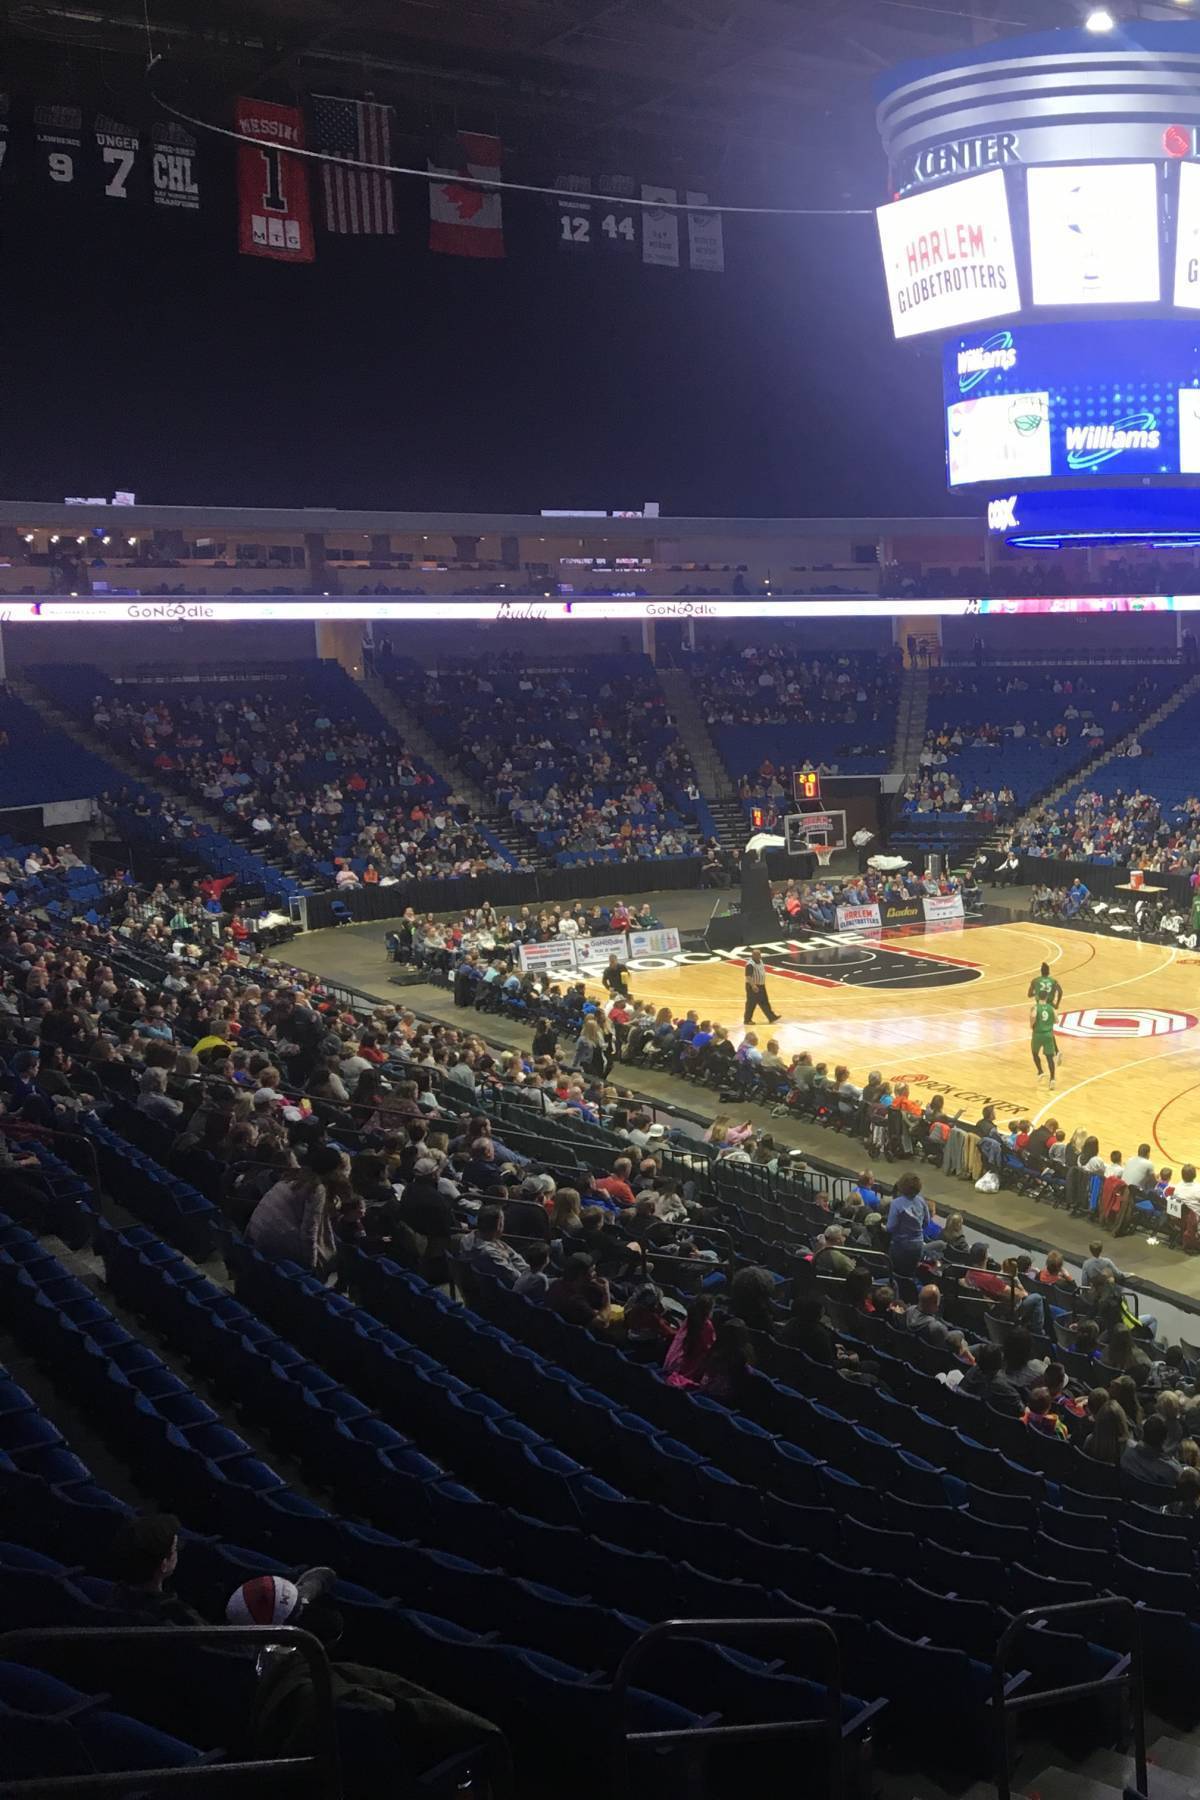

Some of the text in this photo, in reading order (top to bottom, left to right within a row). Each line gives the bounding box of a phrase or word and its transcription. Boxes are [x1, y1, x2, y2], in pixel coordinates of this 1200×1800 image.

[96, 133, 140, 150] UNGER
[48, 152, 74, 182] 9
[920, 133, 1020, 178] CENTER
[103, 147, 135, 198] 7
[153, 153, 199, 194] CHL
[261, 144, 289, 214] 1
[560, 215, 591, 242] 12
[602, 214, 635, 241] 44
[906, 224, 986, 277] HARLEM
[898, 265, 1007, 314] GLOBETROTTERS
[957, 347, 1017, 375] Williams
[1066, 425, 1160, 450] Williams
[127, 603, 214, 618] GoNoodle
[646, 601, 718, 617] GoNoodle
[844, 908, 873, 920] HARLEM
[886, 907, 918, 918] Baden
[1039, 982, 1052, 993] 25
[1041, 1011, 1049, 1021] 9
